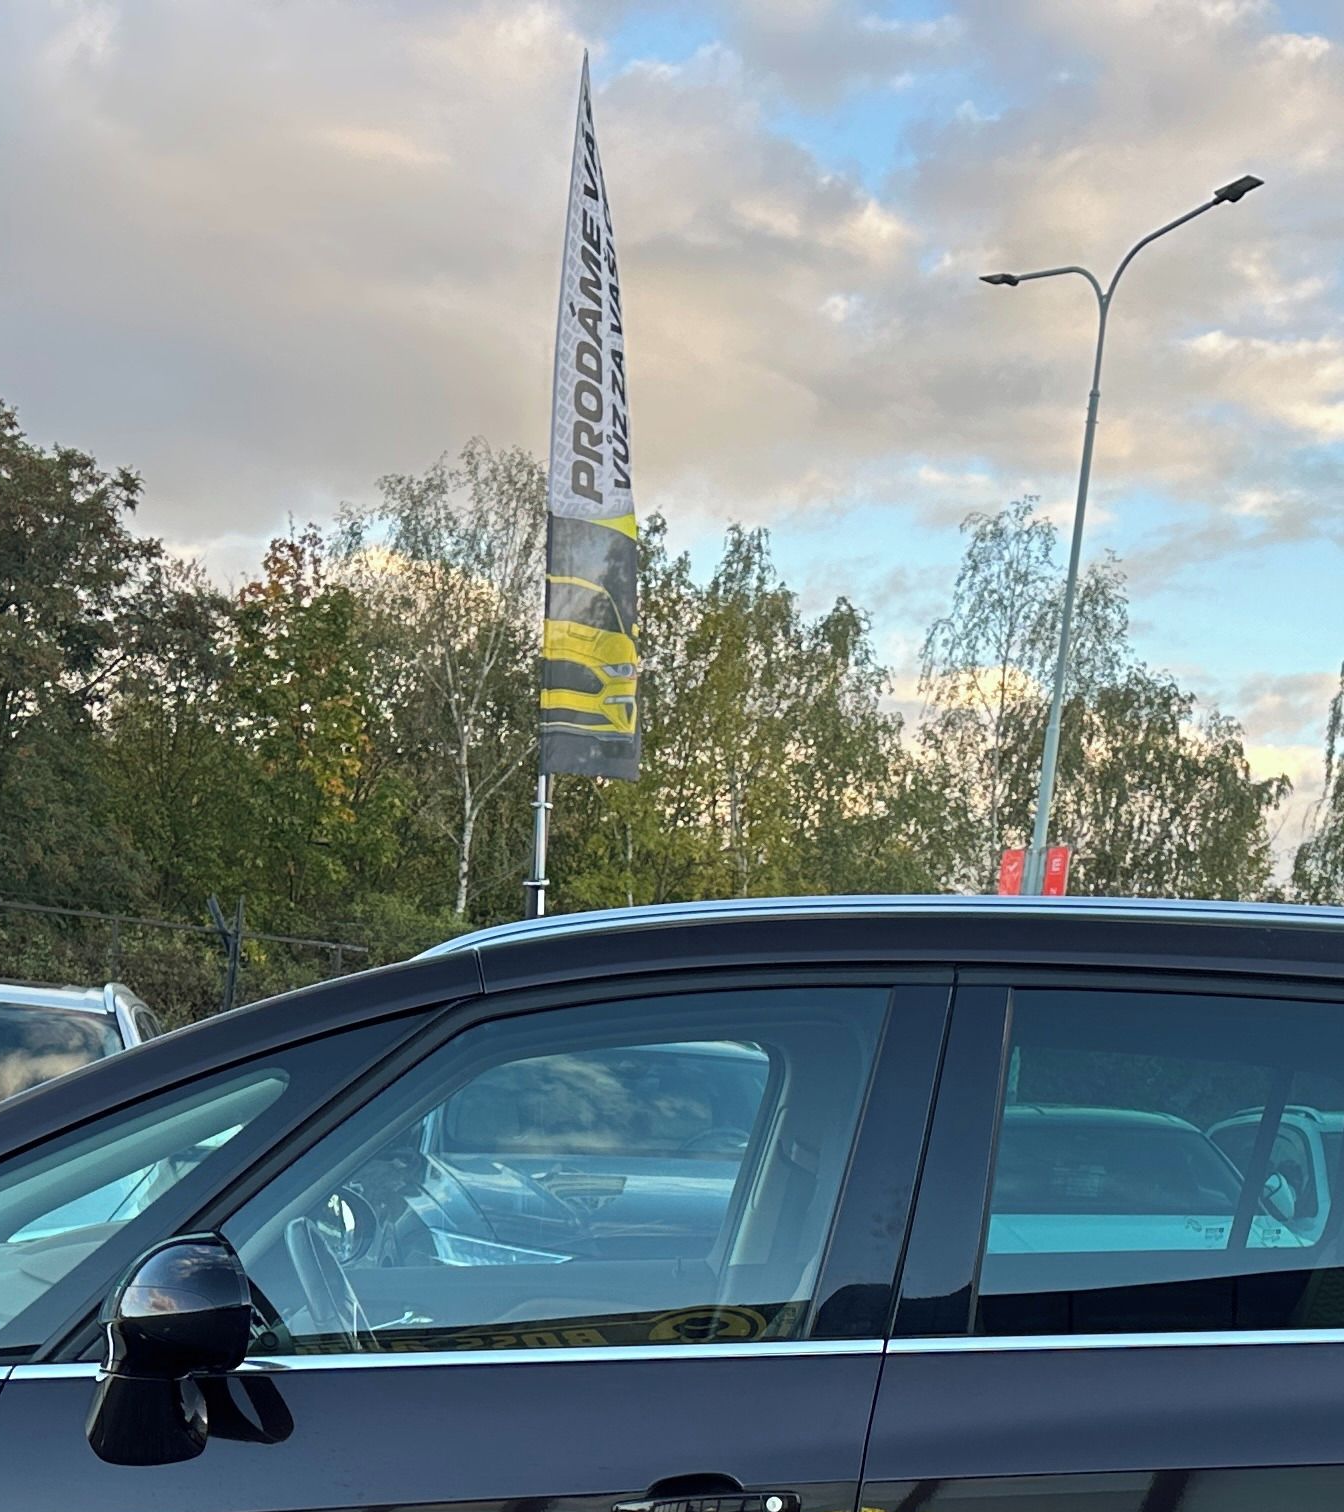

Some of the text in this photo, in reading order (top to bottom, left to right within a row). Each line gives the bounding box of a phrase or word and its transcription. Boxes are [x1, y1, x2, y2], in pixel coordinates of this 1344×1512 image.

[569, 207, 604, 505] PRODÁME
[611, 349, 626, 404] ZA
[606, 404, 631, 489] VŮZ
